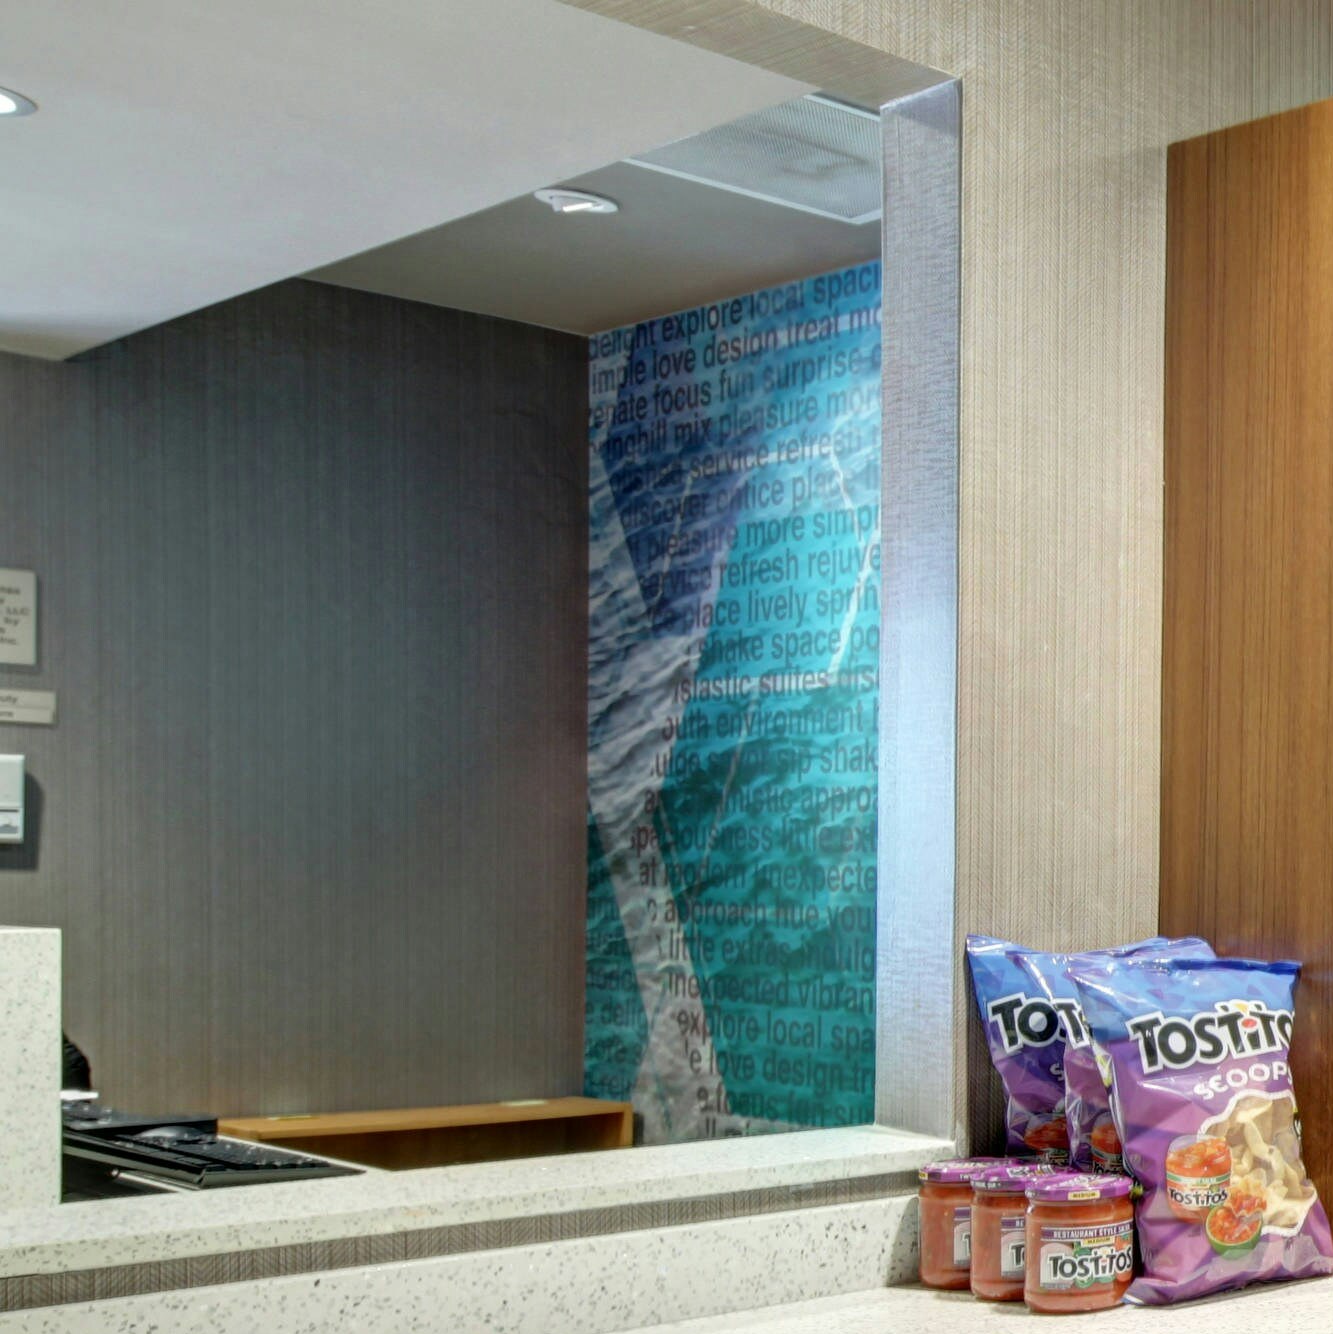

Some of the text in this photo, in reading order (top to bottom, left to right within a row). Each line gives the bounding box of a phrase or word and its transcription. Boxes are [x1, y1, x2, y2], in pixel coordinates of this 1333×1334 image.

[662, 298, 743, 342] explore
[654, 313, 841, 381] love design treat
[654, 344, 861, 415] focus fun surprise
[674, 393, 818, 448] mix pleasure
[745, 510, 805, 545] more
[719, 554, 799, 587] refresh
[749, 586, 807, 627] lively
[701, 630, 841, 666] shake space
[758, 669, 829, 696] suites
[715, 704, 864, 739] environment
[669, 930, 715, 962] little
[676, 1006, 822, 1046] explore local
[709, 1050, 845, 1096] love design
[1054, 1226, 1117, 1238] RESTAURANT STYLE
